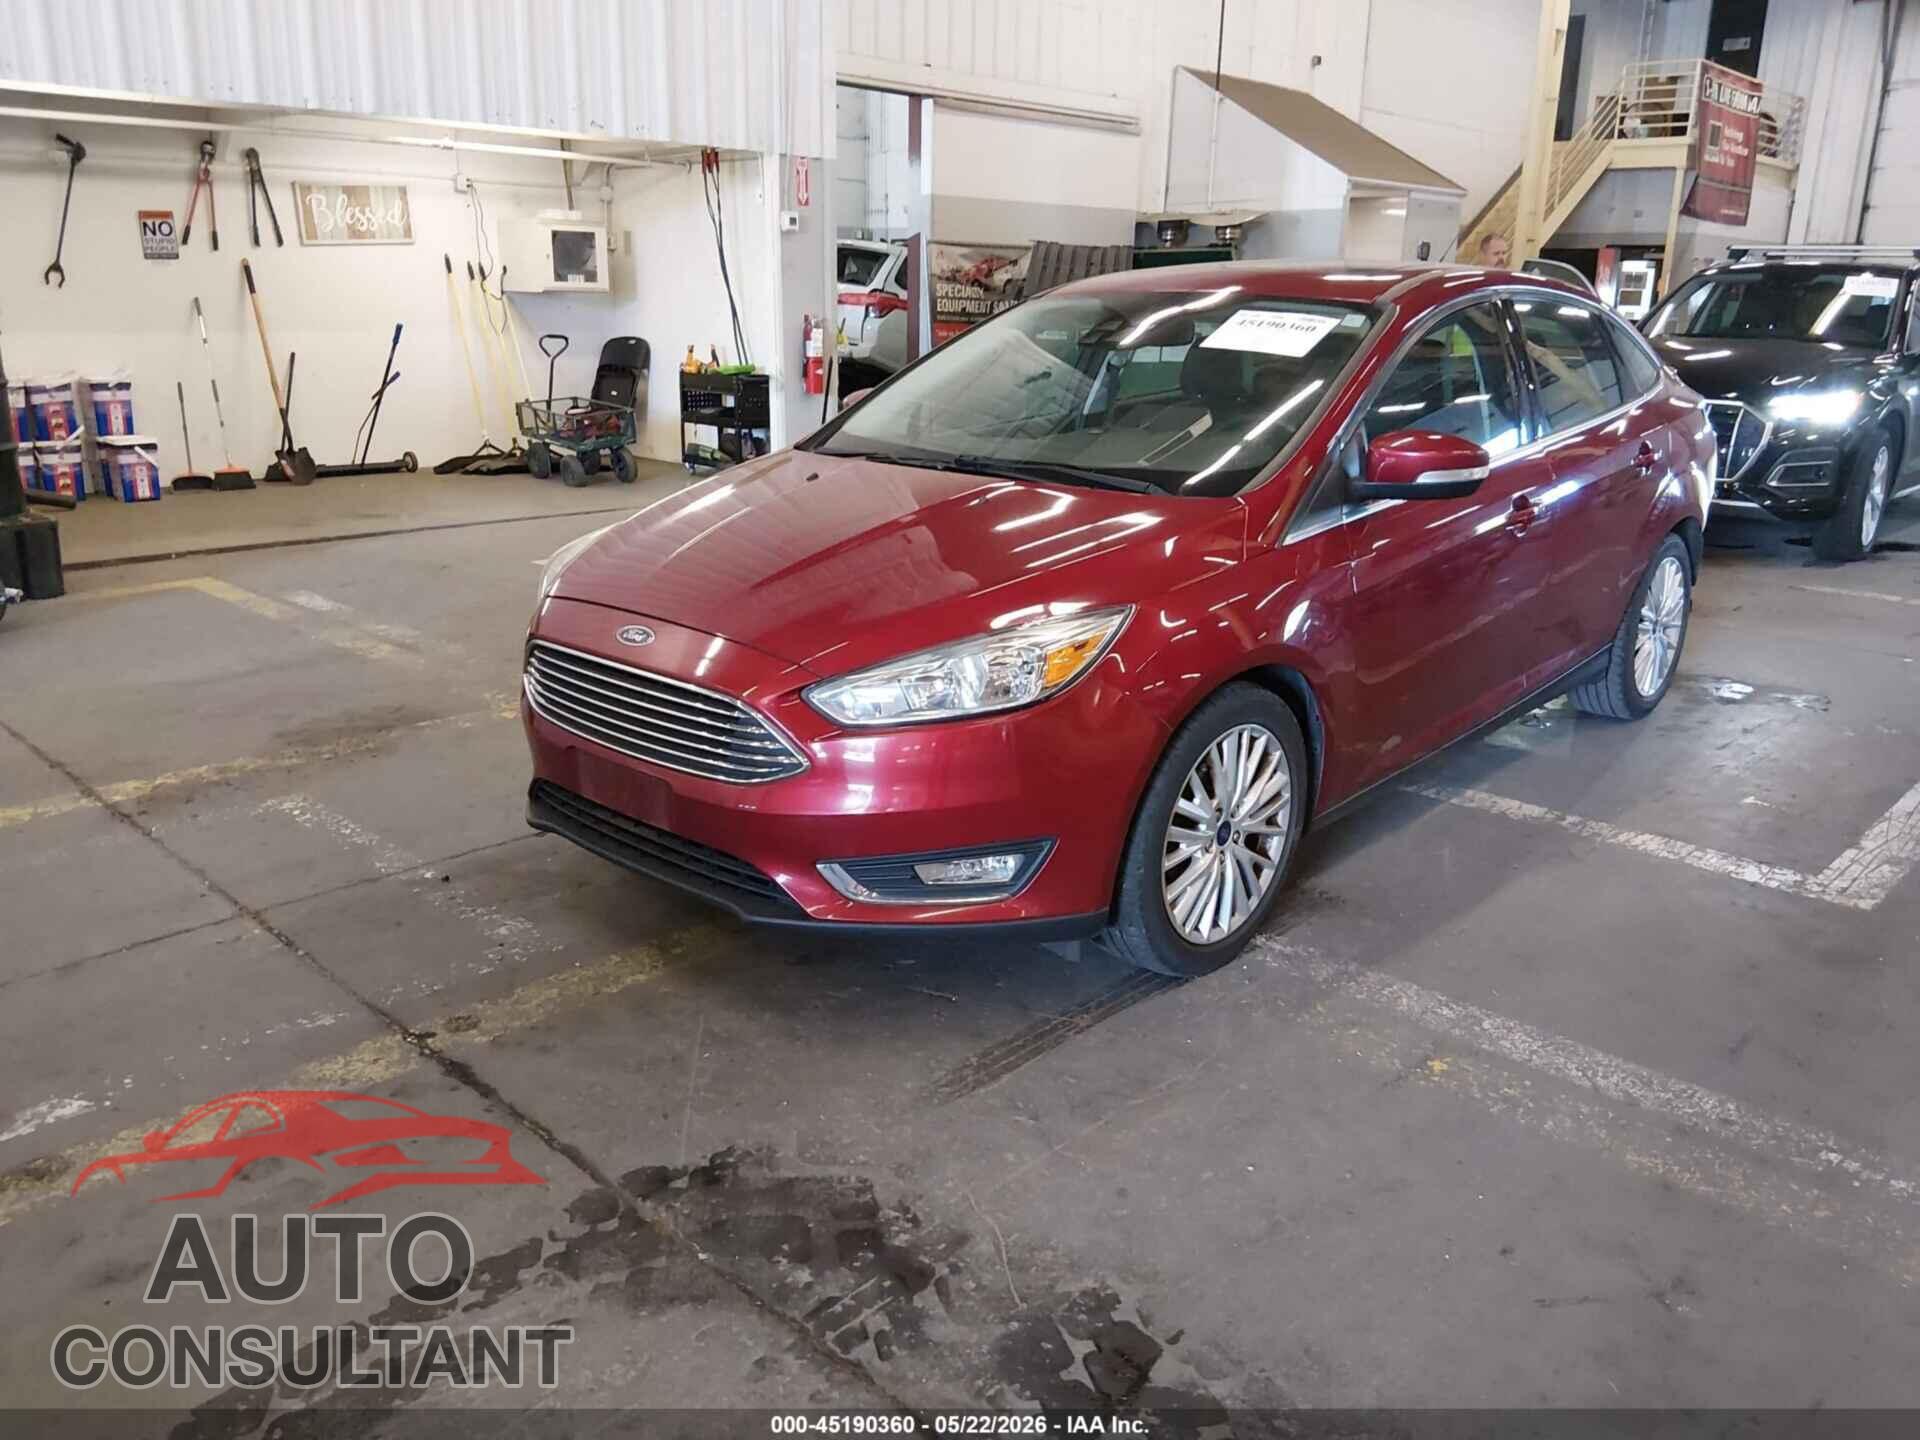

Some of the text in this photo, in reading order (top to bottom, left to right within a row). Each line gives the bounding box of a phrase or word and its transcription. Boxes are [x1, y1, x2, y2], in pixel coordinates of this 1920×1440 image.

[305, 193, 408, 233] Blessed
[143, 221, 173, 237] NO
[937, 299, 992, 314] EQUIPMENT
